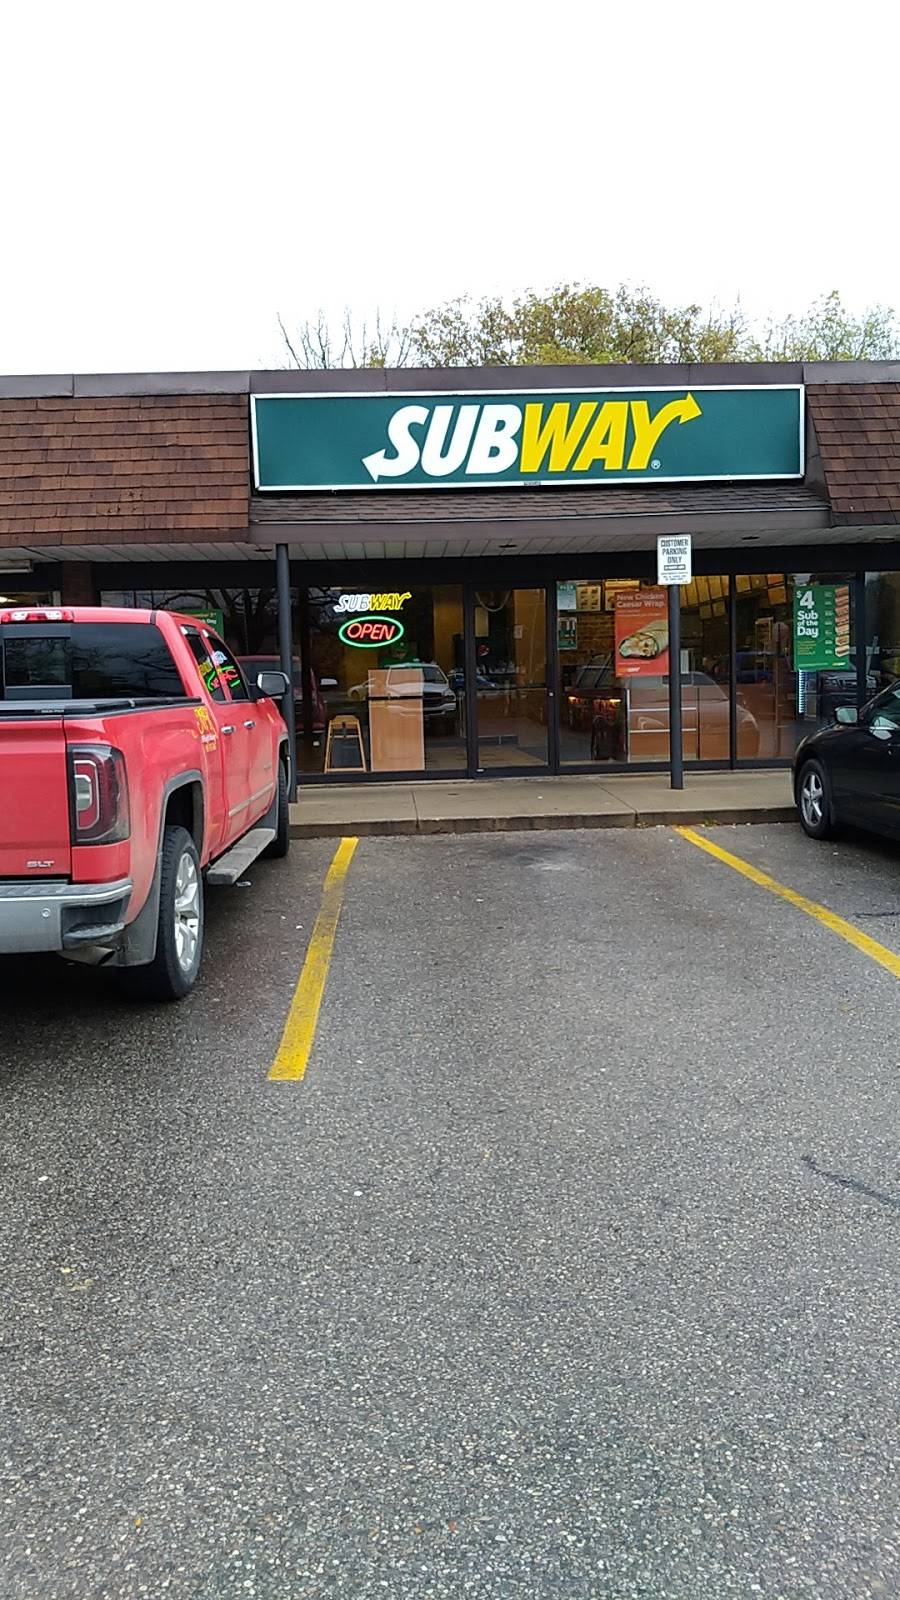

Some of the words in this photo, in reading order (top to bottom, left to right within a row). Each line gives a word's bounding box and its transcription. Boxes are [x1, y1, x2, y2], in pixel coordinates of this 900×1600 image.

[362, 392, 702, 482] SUBWAY
[660, 538, 689, 547] CUSTOMER
[662, 547, 688, 556] PARKING
[667, 556, 683, 564] ONLY
[333, 592, 412, 612] SUBWAY
[797, 610, 818, 620] Sub
[346, 622, 395, 640] OPEN
[797, 626, 819, 638] Day
[26, 860, 55, 868] SLT
